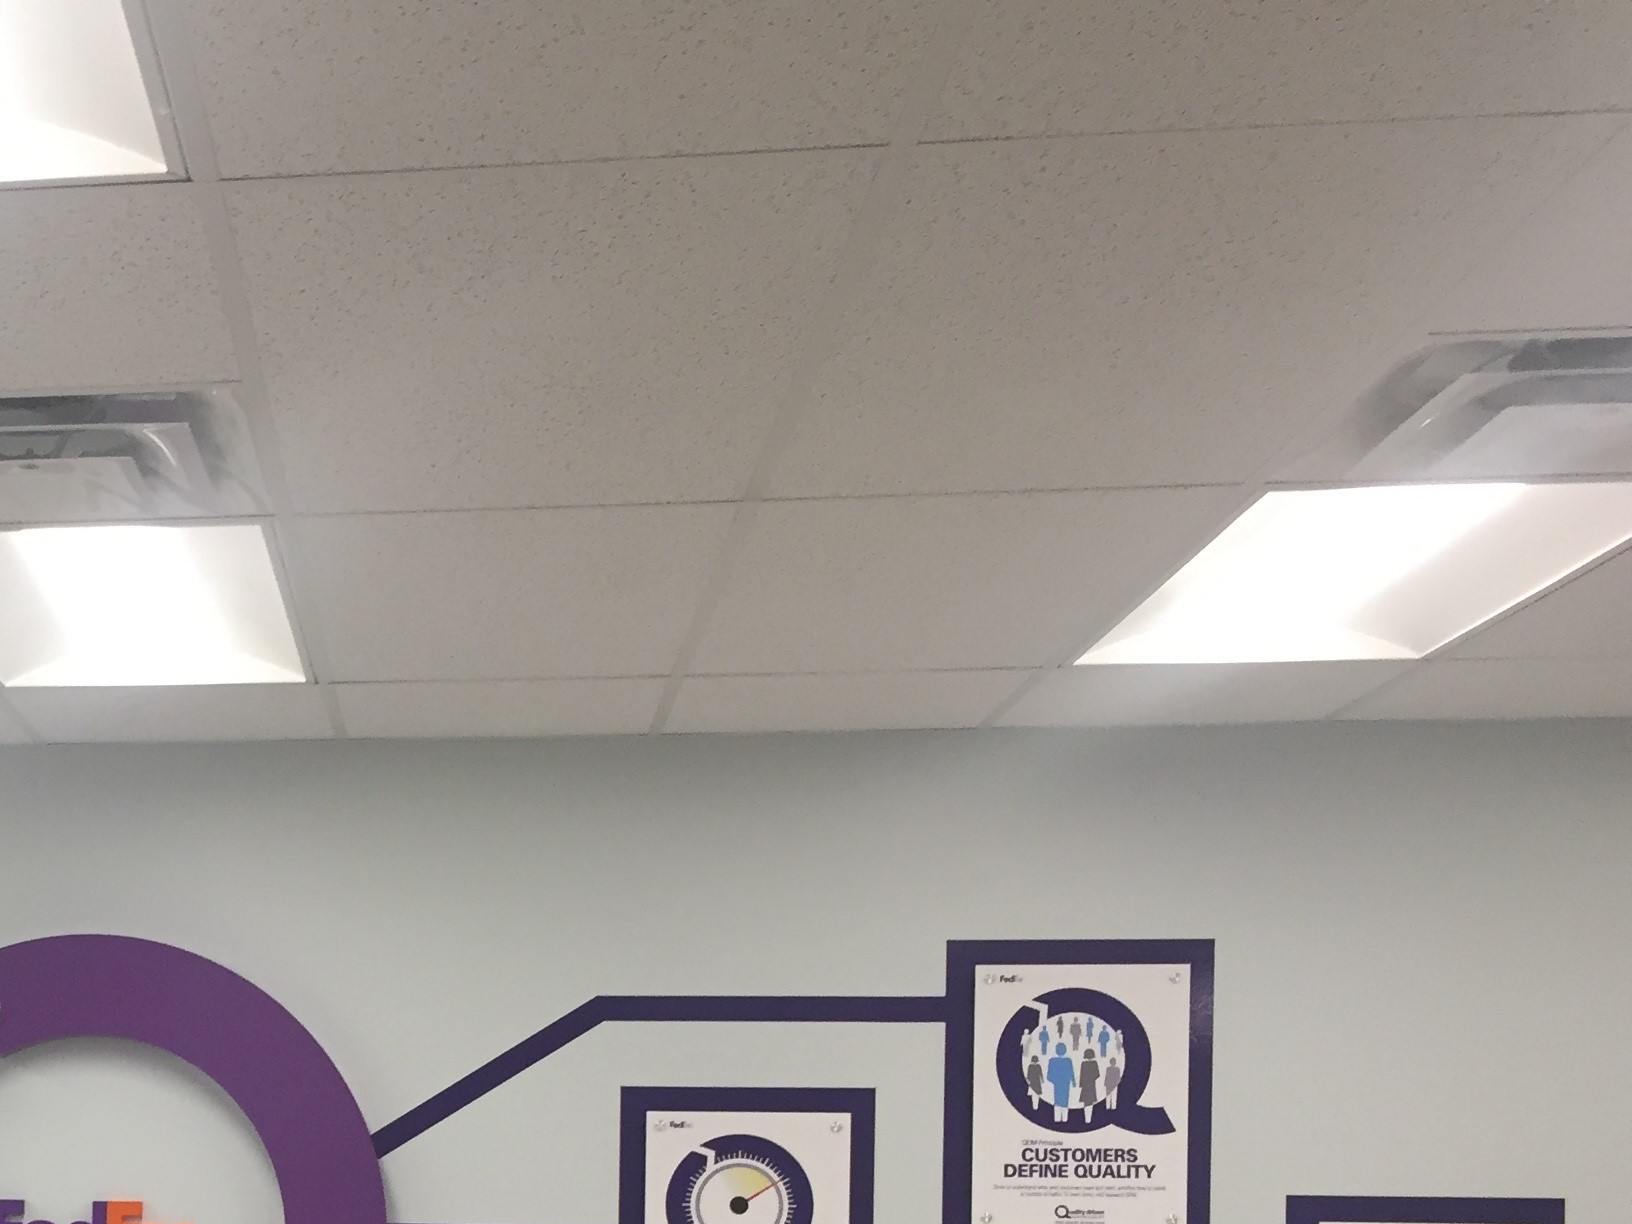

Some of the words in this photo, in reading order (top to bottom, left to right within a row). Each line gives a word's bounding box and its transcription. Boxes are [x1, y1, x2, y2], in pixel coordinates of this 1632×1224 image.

[1021, 1148, 1138, 1163] CUSTOMERS
[1003, 1164, 1069, 1178] DEFINE
[1074, 1164, 1157, 1179] QUALITY
